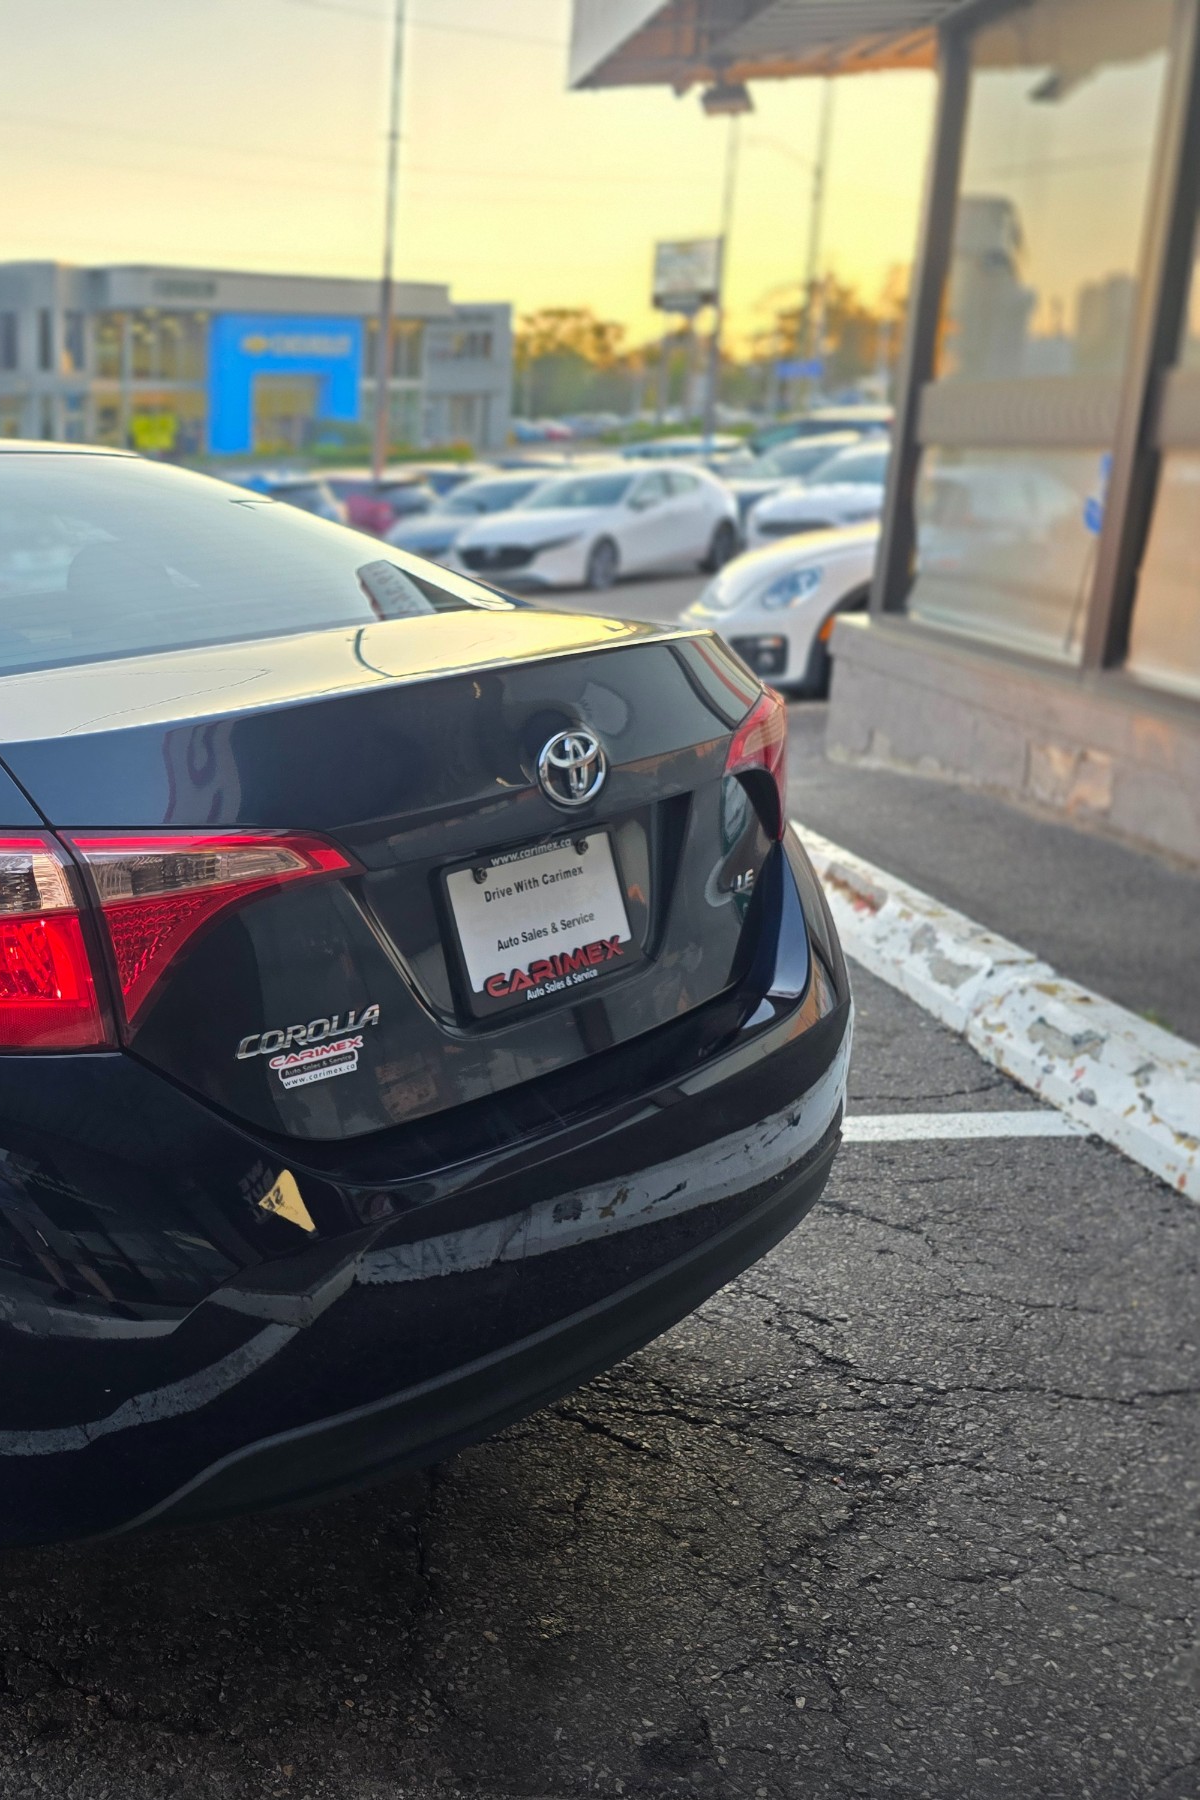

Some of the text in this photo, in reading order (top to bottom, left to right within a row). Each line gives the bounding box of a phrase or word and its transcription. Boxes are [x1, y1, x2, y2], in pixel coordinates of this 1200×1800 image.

[484, 866, 584, 903] Drive With Carimex
[497, 912, 595, 952] Auto Sales & Service
[483, 934, 624, 998] CARIMEX
[526, 967, 598, 1001] Auto Sales & Service
[236, 1003, 380, 1060] COROLLA
[270, 1037, 362, 1068] CARIMEX
[285, 1053, 352, 1077] Auto Sales & Service
[284, 1063, 356, 1088] www.carimex.ca
